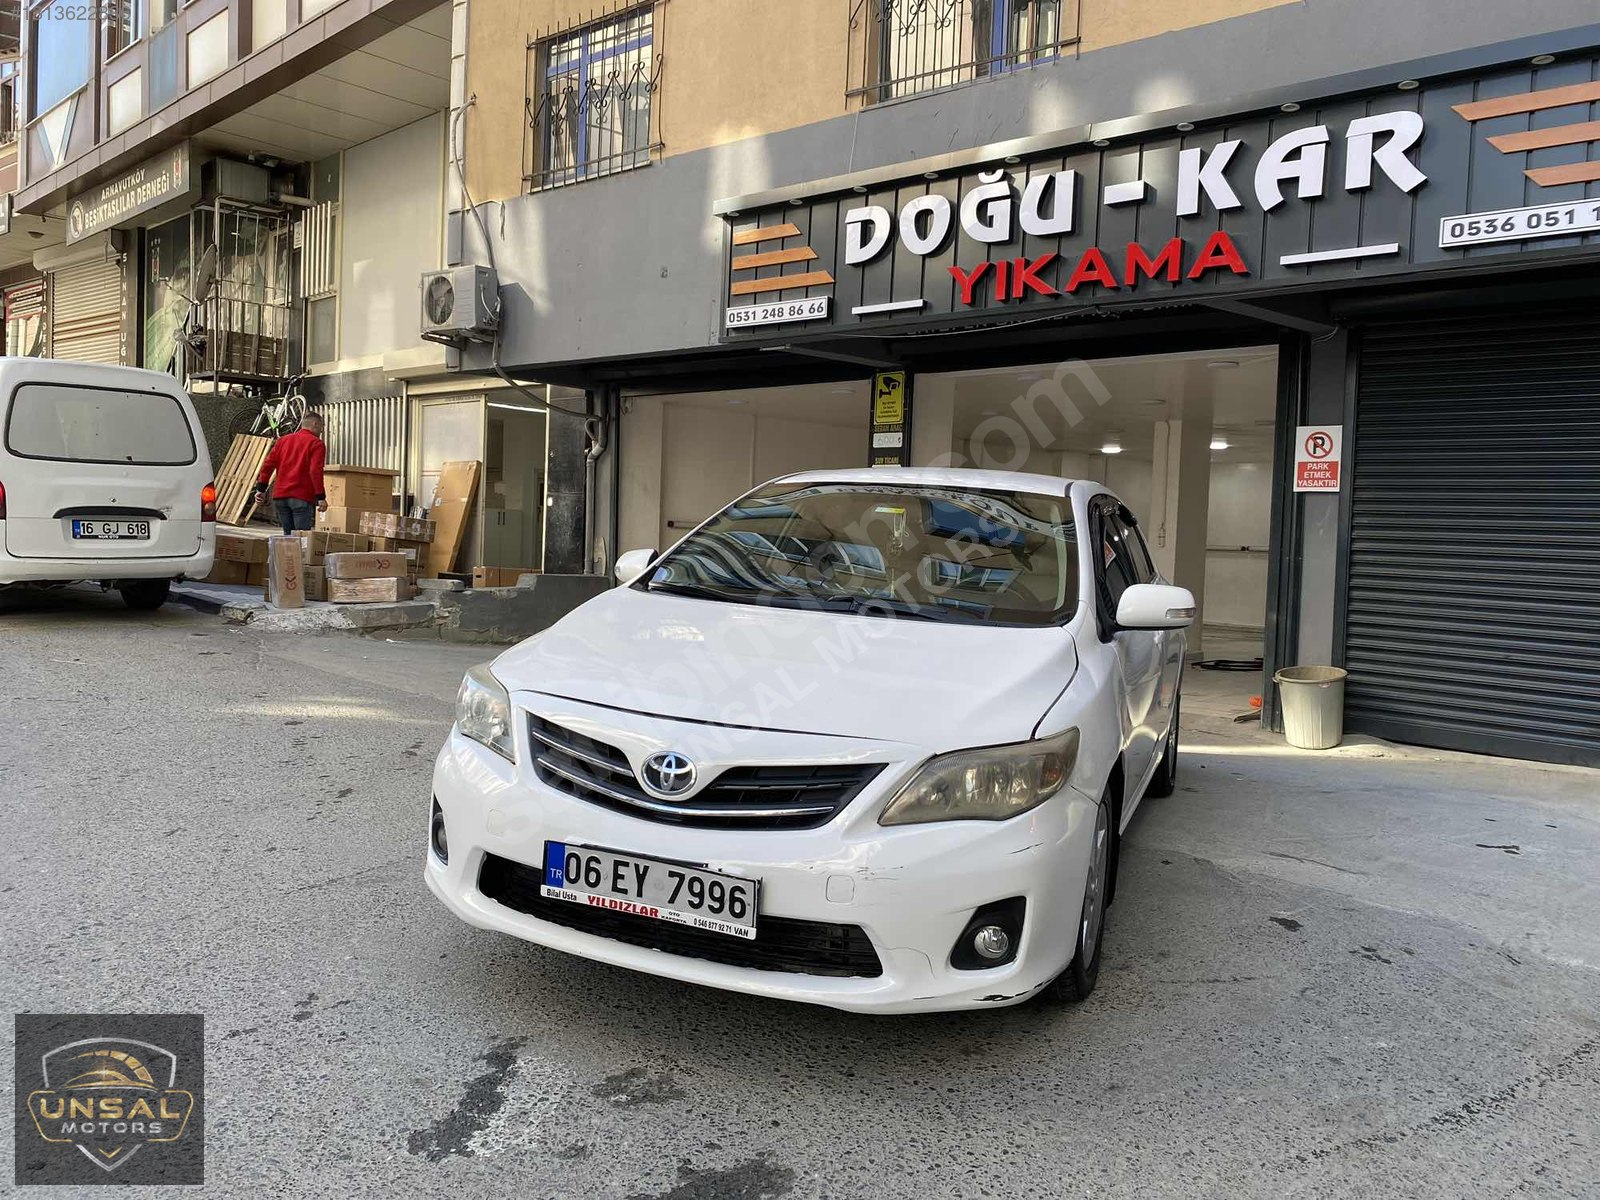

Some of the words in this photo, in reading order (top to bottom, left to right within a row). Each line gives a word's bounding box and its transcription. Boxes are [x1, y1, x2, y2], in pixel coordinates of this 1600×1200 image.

[844, 168, 1078, 266] DOĞU
[1176, 110, 1428, 217] KAR
[1451, 216, 1515, 239] 0536
[1526, 207, 1575, 229] 051
[947, 230, 1249, 306] YIKAMA
[729, 311, 757, 323] 0531
[762, 307, 784, 319] 248
[788, 304, 804, 316] 86
[809, 302, 825, 314] 66
[1304, 471, 1332, 479] ETMEK
[81, 523, 94, 535] 16
[102, 523, 119, 535] GJ
[127, 524, 147, 535] 618
[550, 867, 563, 880] TR
[546, 888, 561, 898] Bilal
[562, 891, 577, 901] Usta
[564, 852, 602, 888] 06
[611, 859, 650, 898] EY
[667, 870, 747, 919] 7996
[587, 895, 659, 918] YILDIZLAR
[698, 919, 707, 928] 546
[708, 921, 718, 930] 877
[718, 923, 725, 931] 92
[725, 925, 732, 933] 71
[733, 927, 749, 937] VAN
